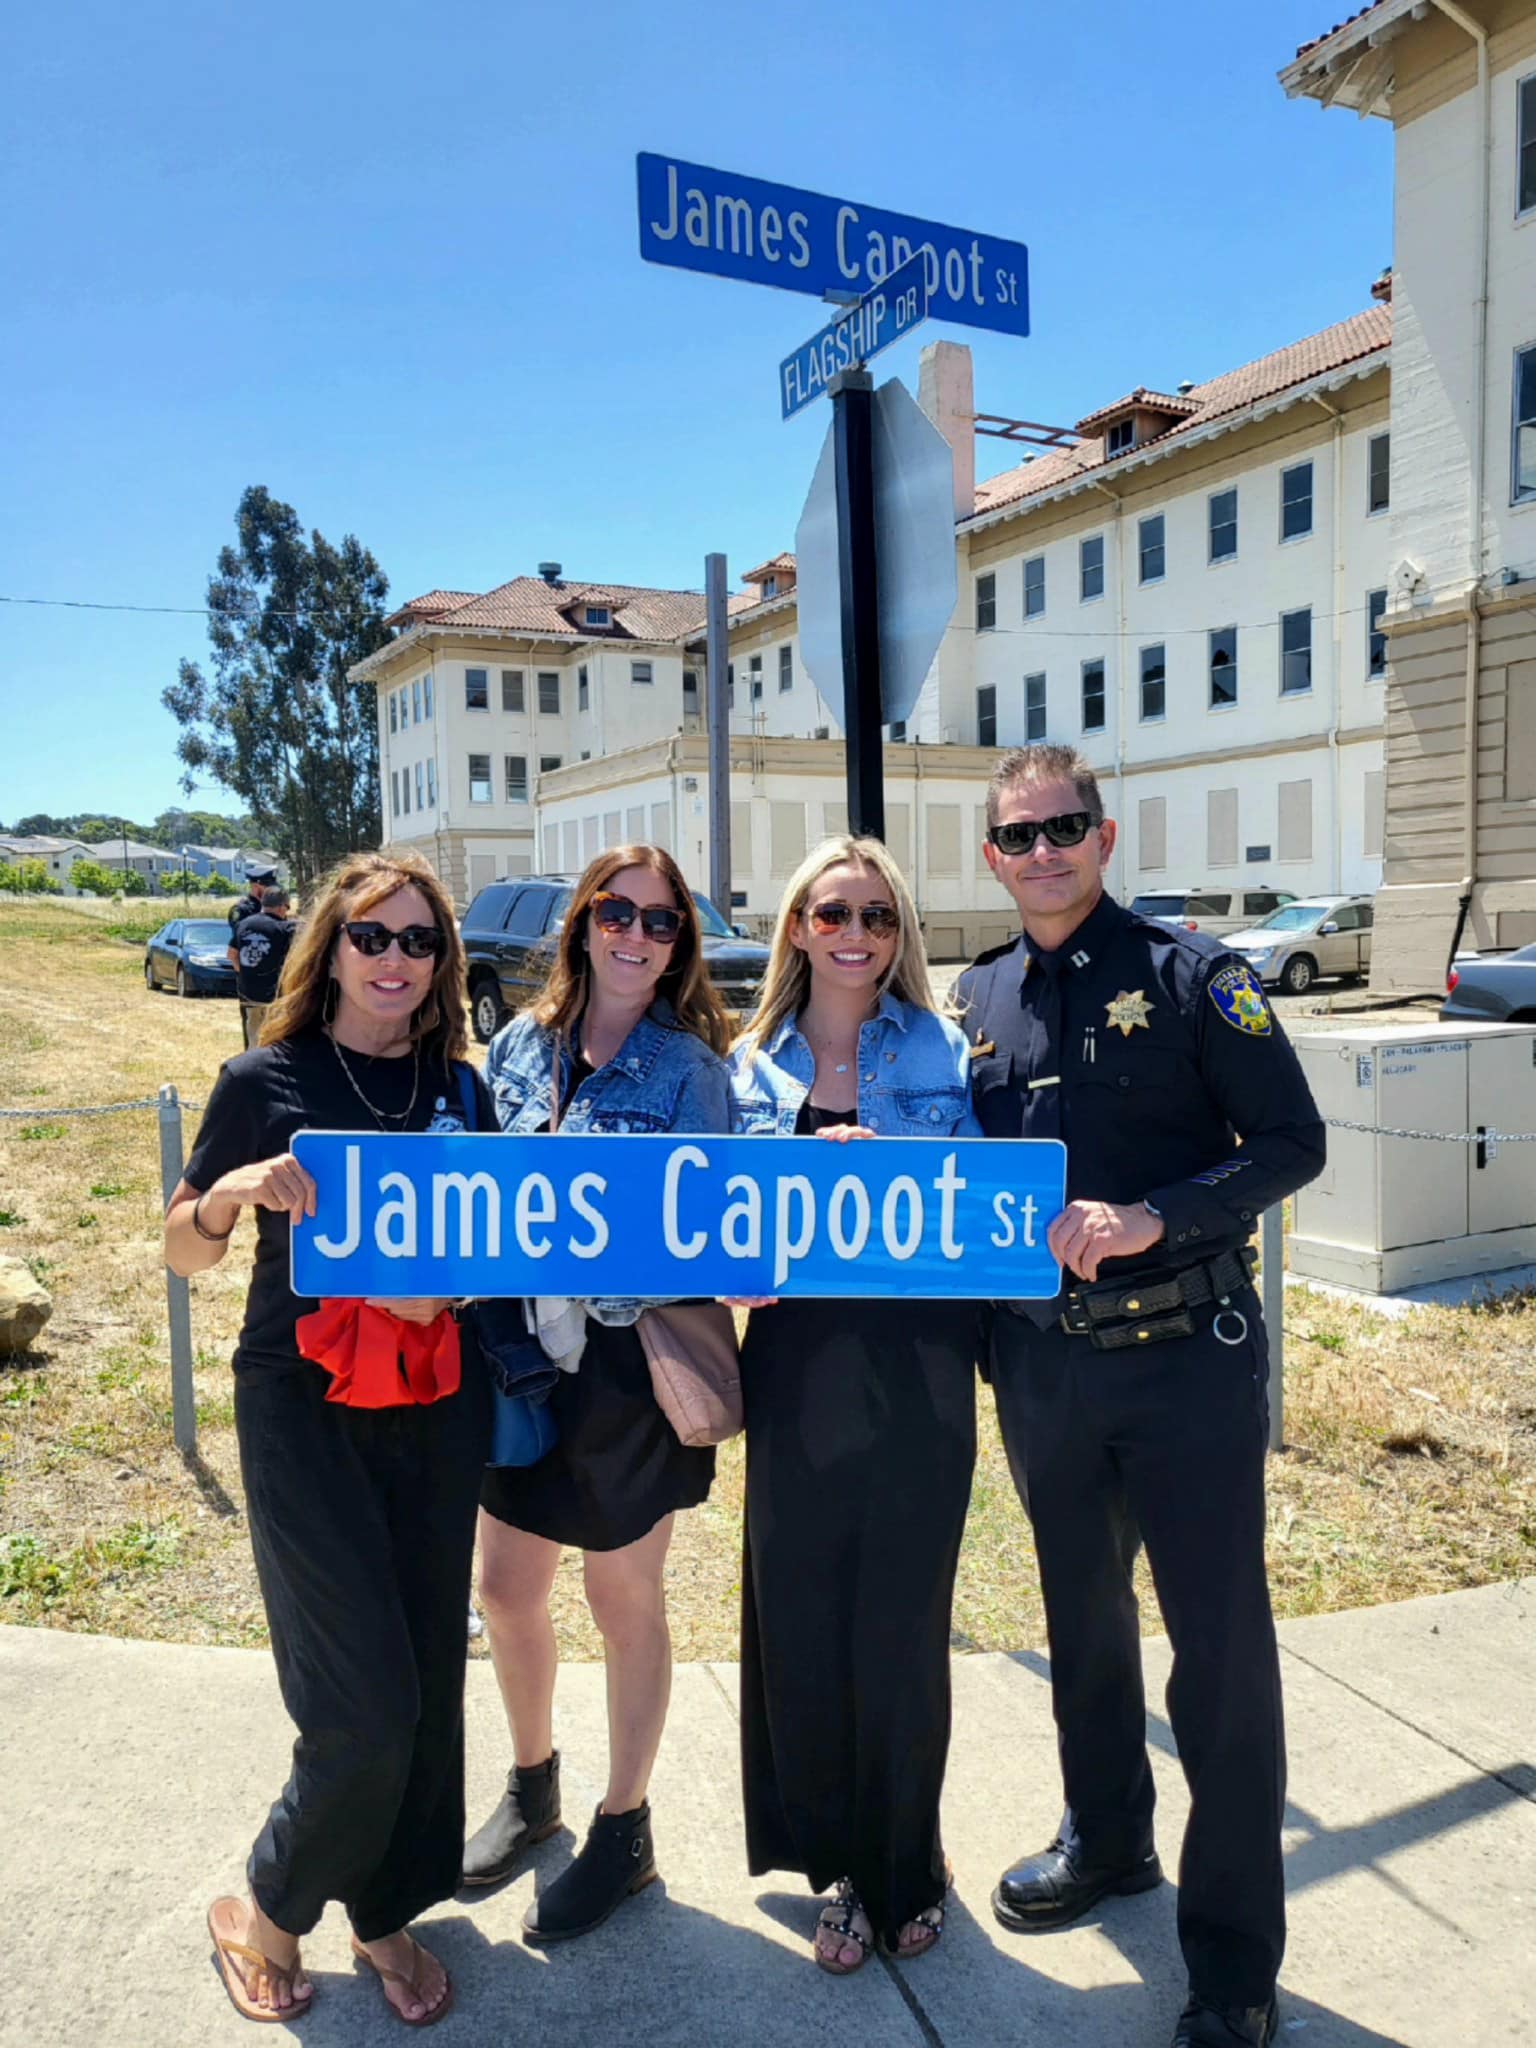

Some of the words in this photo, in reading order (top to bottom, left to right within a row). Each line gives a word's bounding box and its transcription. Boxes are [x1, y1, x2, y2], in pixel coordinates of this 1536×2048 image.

[651, 165, 810, 268] James
[996, 268, 1018, 305] St
[784, 293, 886, 410] FLAGSHIP
[895, 286, 918, 330] DR
[313, 1145, 609, 1259] James
[664, 1145, 967, 1288] Capoot
[990, 1190, 1038, 1249] St
